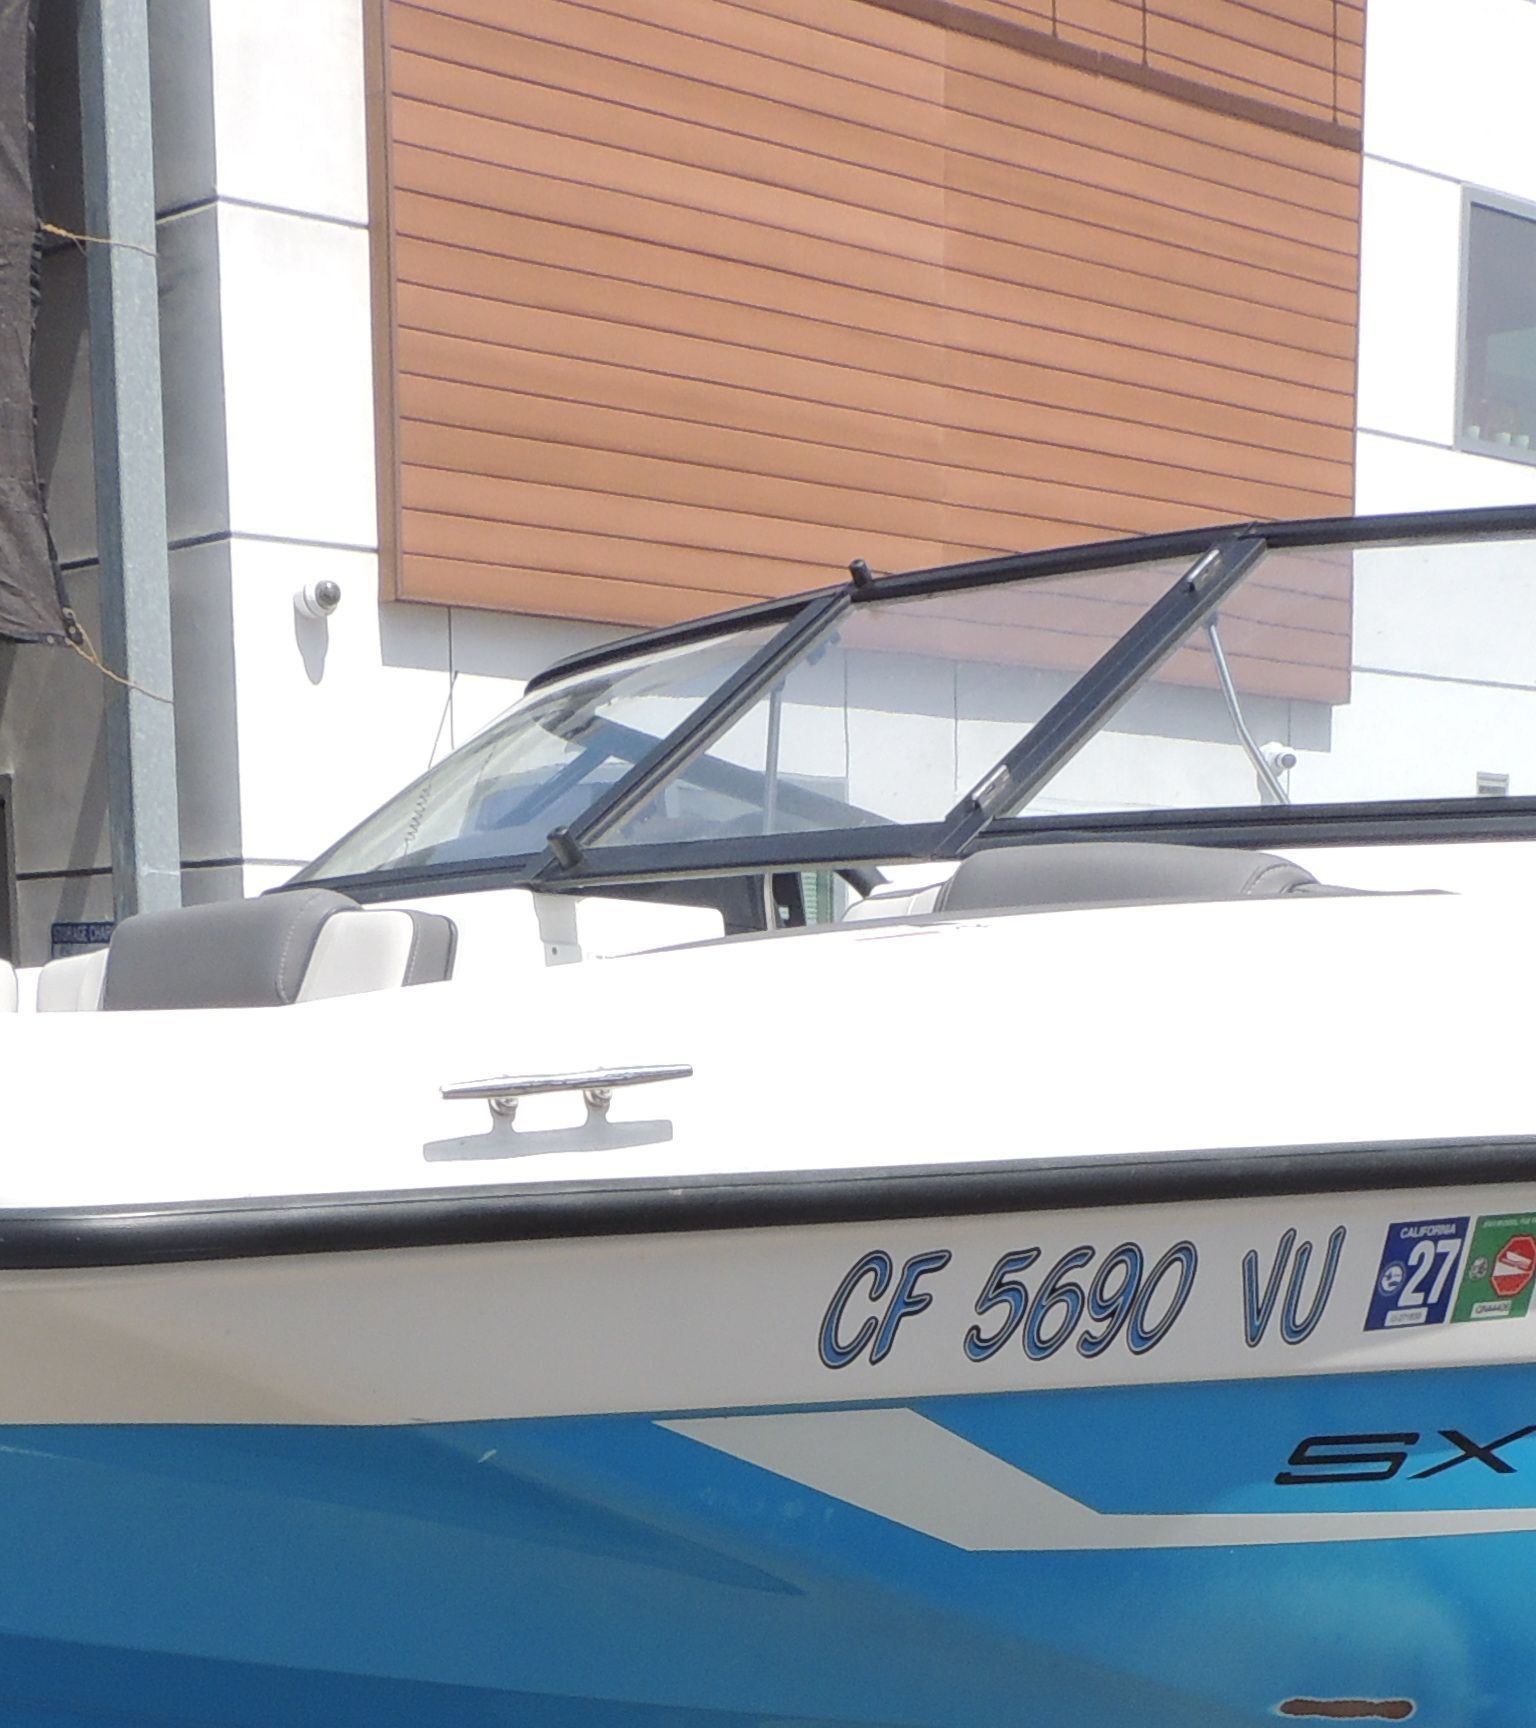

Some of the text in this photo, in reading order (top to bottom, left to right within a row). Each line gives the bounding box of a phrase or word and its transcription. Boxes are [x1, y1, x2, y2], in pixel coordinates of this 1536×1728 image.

[1400, 1223, 1457, 1240] CALIFORNIA
[818, 1226, 1347, 1369] CF 5690 VU
[1398, 1238, 1462, 1307] 27
